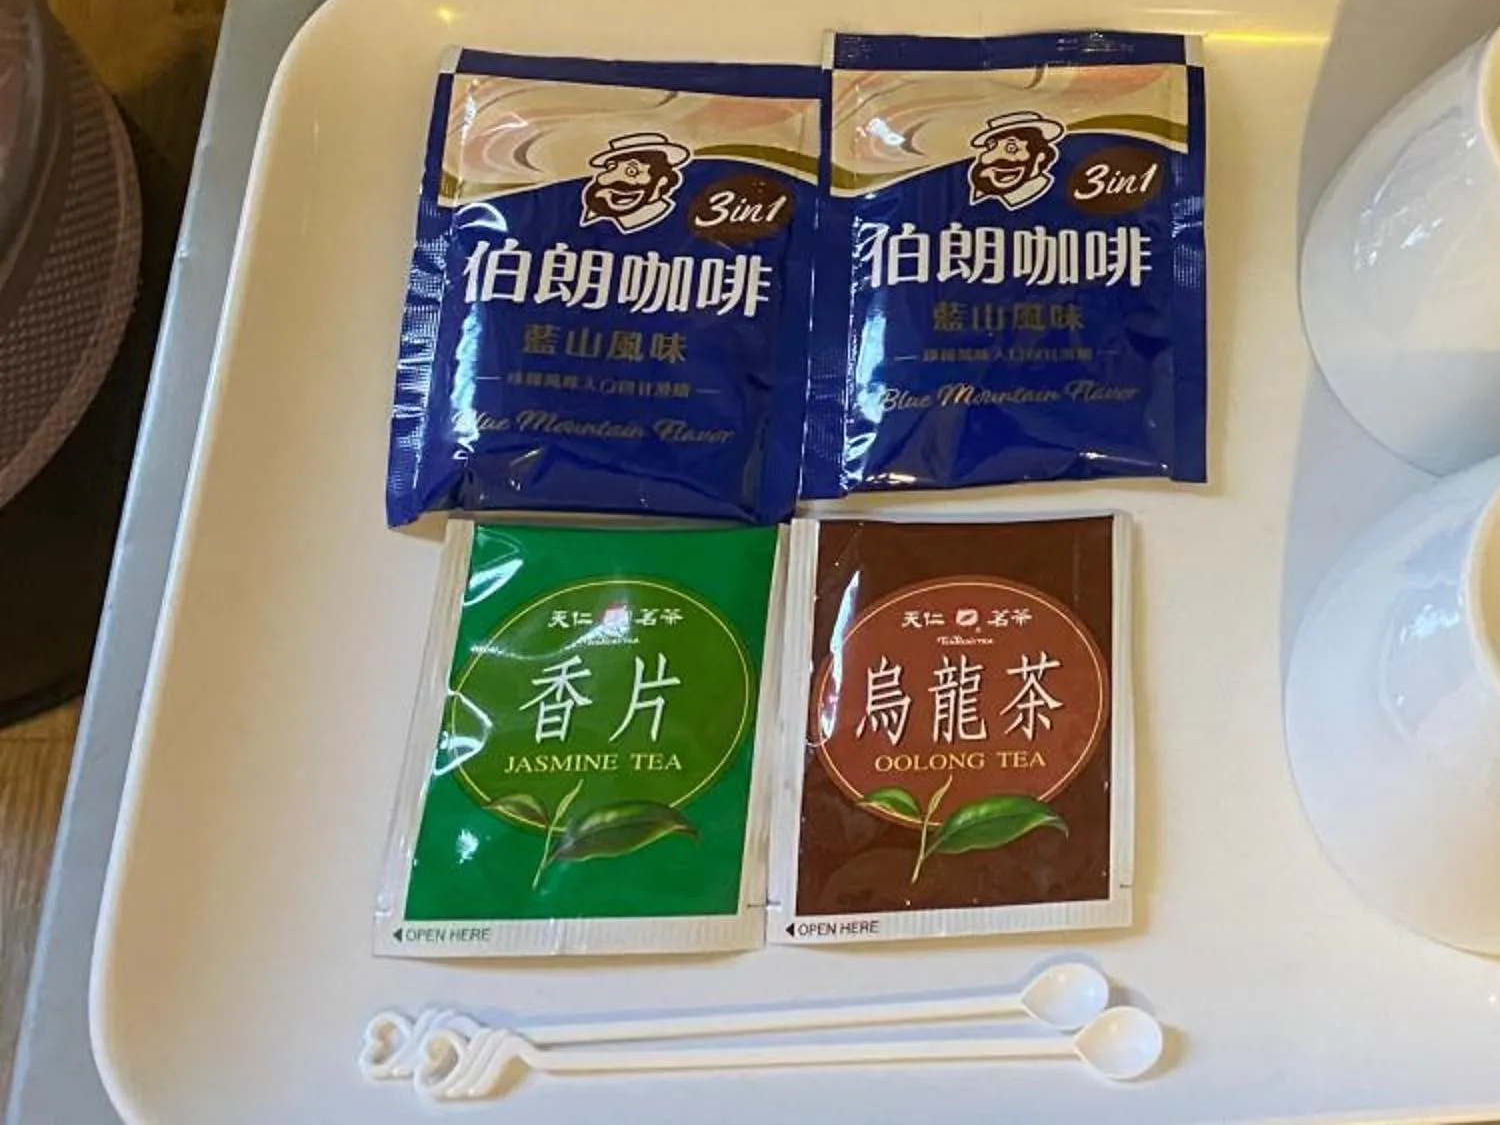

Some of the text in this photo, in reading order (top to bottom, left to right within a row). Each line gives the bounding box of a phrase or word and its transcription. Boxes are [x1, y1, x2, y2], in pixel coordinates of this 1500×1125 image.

[1073, 163, 1159, 201] 3in1
[695, 190, 788, 228] 3in1
[863, 221, 1153, 288] 伯朗咖啡
[462, 237, 773, 318] 伯朗咖啡
[933, 300, 1086, 332] 藍山風味
[522, 323, 687, 363] 藍山風味
[880, 388, 932, 412] Blue
[937, 382, 1060, 406] Mountain
[516, 409, 644, 439] Mountain
[901, 610, 945, 628] 天仁
[518, 651, 681, 744] 香片
[855, 650, 1063, 747] 烏龍茶
[504, 752, 683, 774] JASMINE TEA
[875, 751, 1047, 773] OOLONG TEA
[406, 926, 491, 943] OPEN HERE
[798, 920, 880, 936] OPEN HERE
